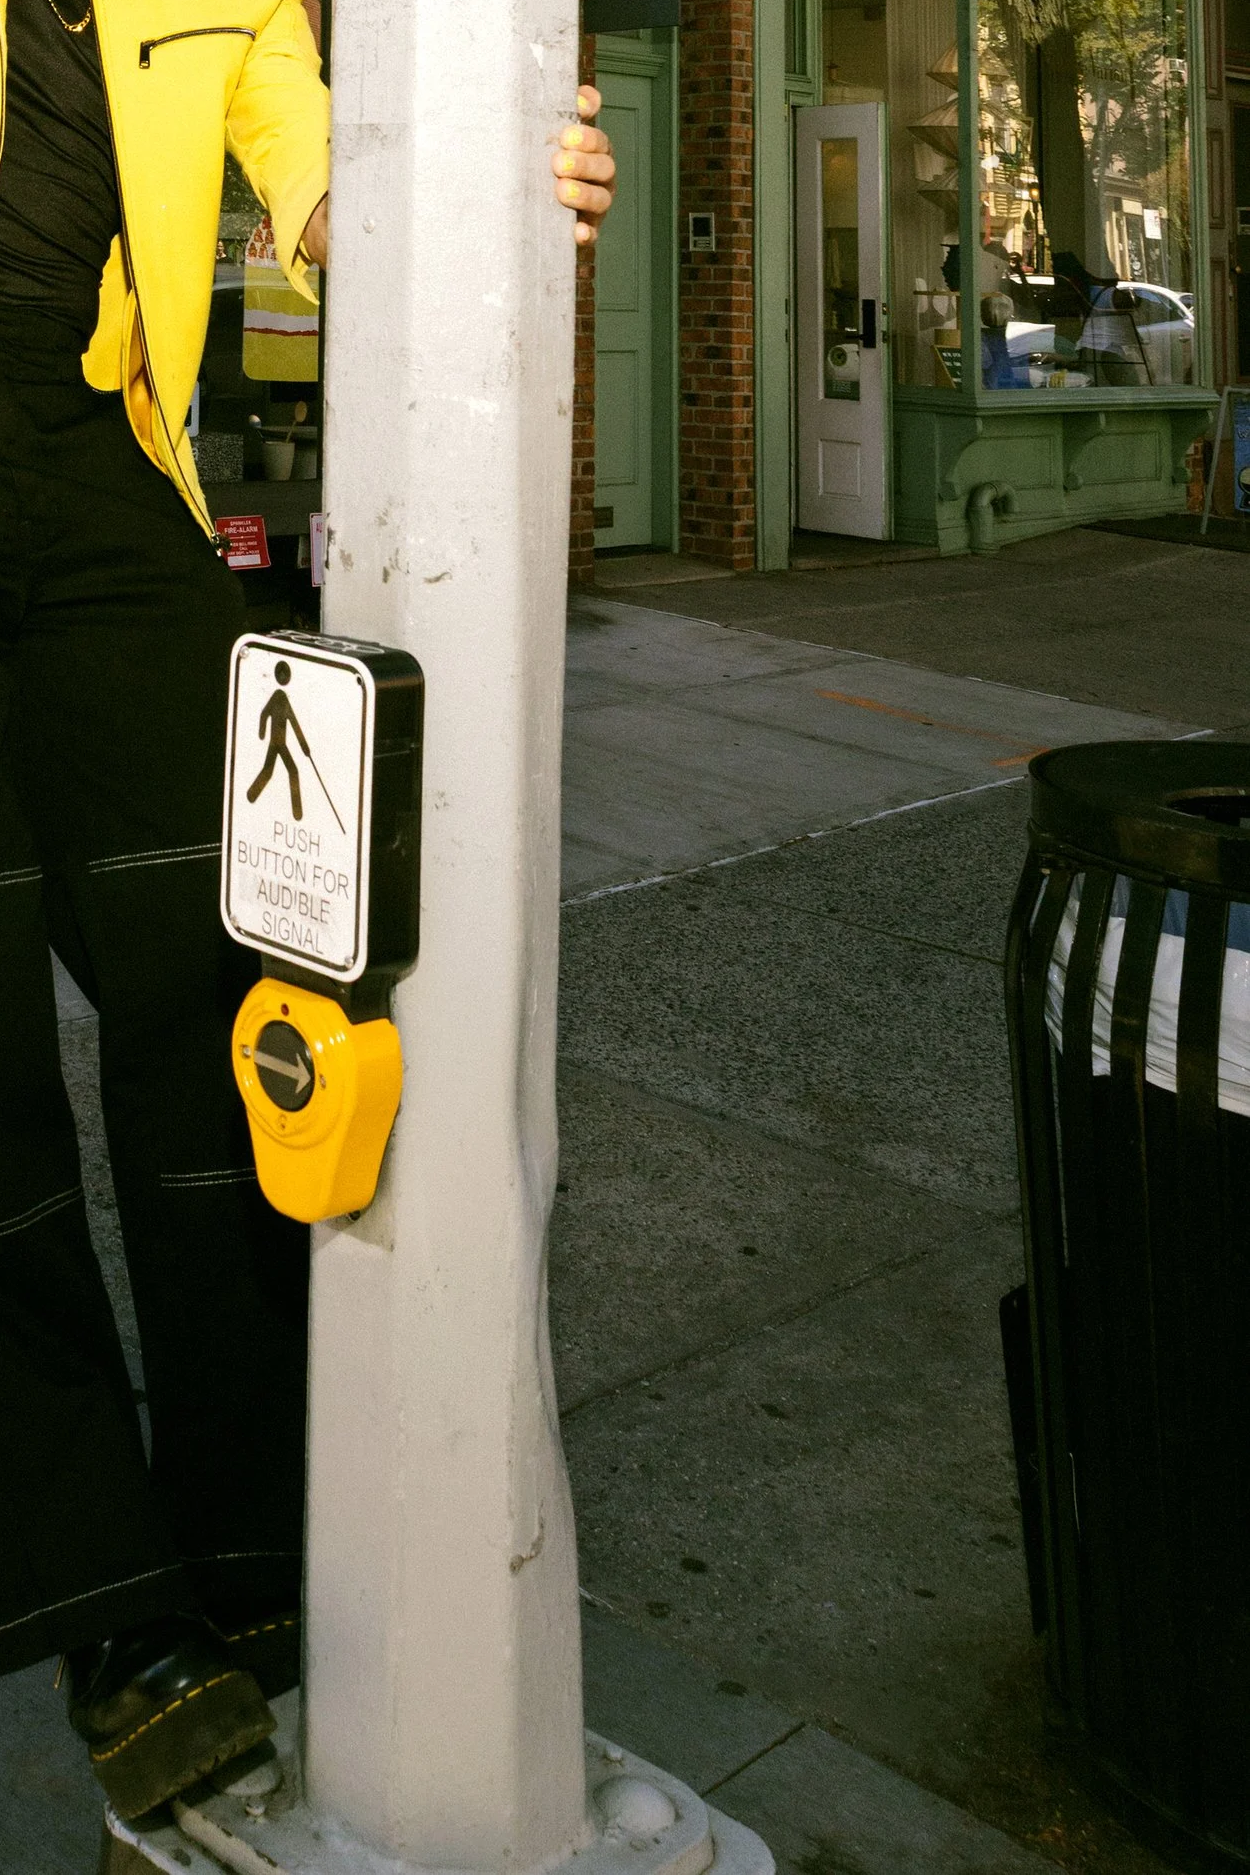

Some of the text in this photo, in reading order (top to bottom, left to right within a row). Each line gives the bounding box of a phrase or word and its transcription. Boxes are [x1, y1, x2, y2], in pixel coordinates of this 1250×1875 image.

[224, 526, 259, 534] FIRE-ALARM
[274, 821, 320, 857] PUSH
[238, 840, 349, 900] BUTTON FOR
[257, 879, 331, 924] AUDIBLE
[262, 911, 324, 954] SIGNAL
